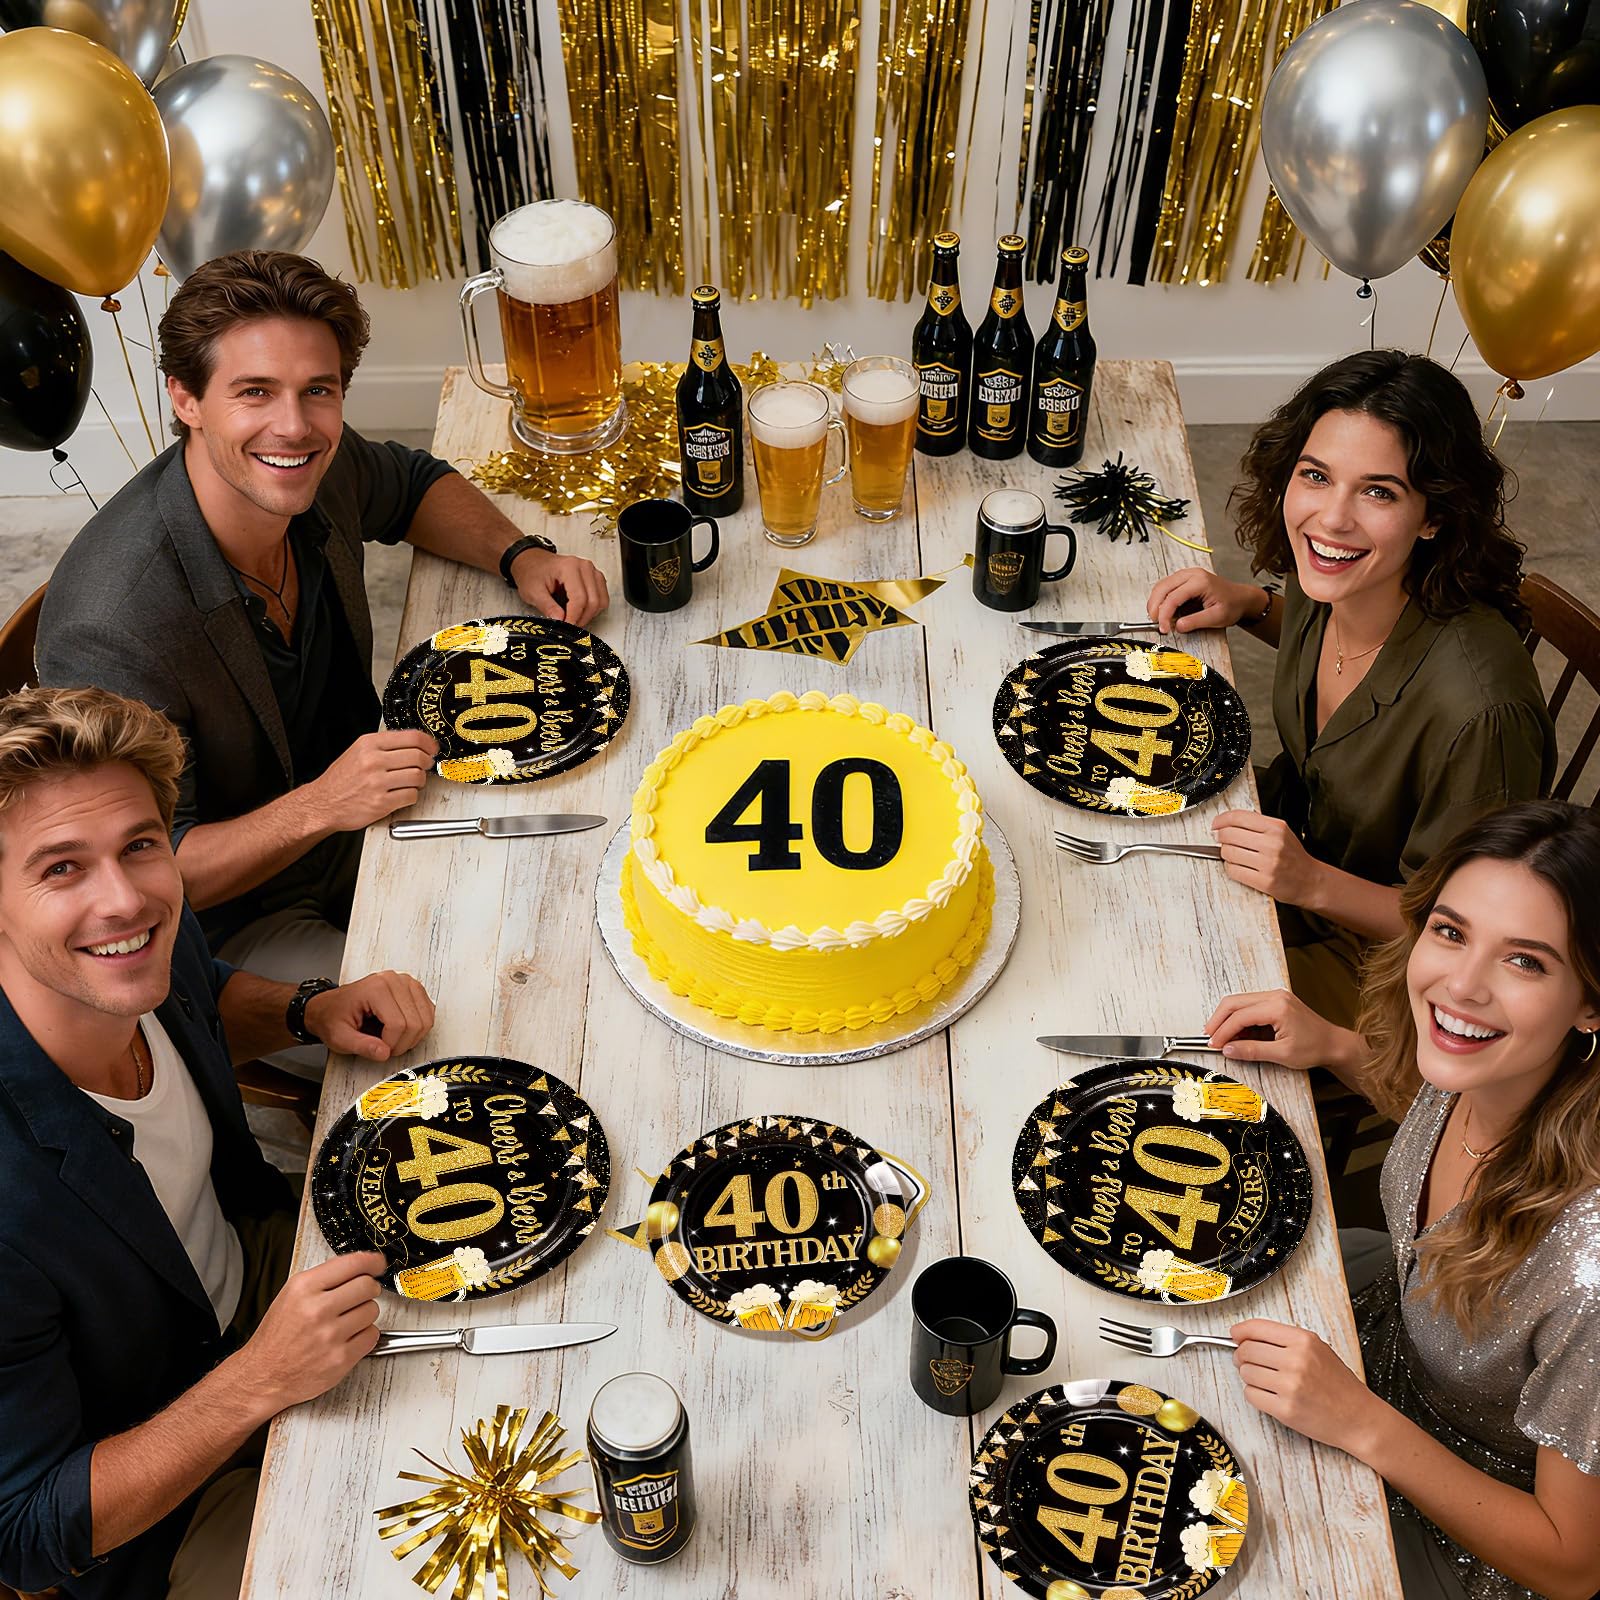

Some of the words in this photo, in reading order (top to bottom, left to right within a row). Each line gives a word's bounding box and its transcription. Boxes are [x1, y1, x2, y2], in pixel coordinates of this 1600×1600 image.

[510, 642, 527, 661] TO
[536, 644, 571, 696] Cheers
[421, 682, 445, 732] YEARS
[454, 658, 538, 744] 40
[543, 699, 560, 709] &
[1056, 663, 1097, 706] Beers
[539, 710, 575, 752] Beers
[1074, 708, 1086, 719] &
[1090, 683, 1180, 776] 40
[1180, 711, 1209, 764] YEARS
[1046, 720, 1089, 776] Cheers
[1091, 765, 1109, 783] TO
[705, 757, 904, 871] 40
[452, 1097, 474, 1122] TO
[483, 1094, 527, 1167] Cheers
[1088, 1096, 1138, 1155] Beers
[396, 1125, 505, 1242] 40
[507, 1170, 527, 1183] &
[1108, 1158, 1121, 1170] &
[1123, 1125, 1231, 1250] 40
[362, 1164, 396, 1232] YEARS
[506, 1183, 549, 1245] Beers
[703, 1170, 849, 1238] 40th
[1070, 1172, 1123, 1247] Cheers
[1228, 1165, 1263, 1234] YEARS
[694, 1232, 864, 1274] BIRTHDAY
[1121, 1232, 1143, 1256] TO
[1036, 1423, 1129, 1564] 40th
[1115, 1429, 1179, 1587] BIRTHDAY
